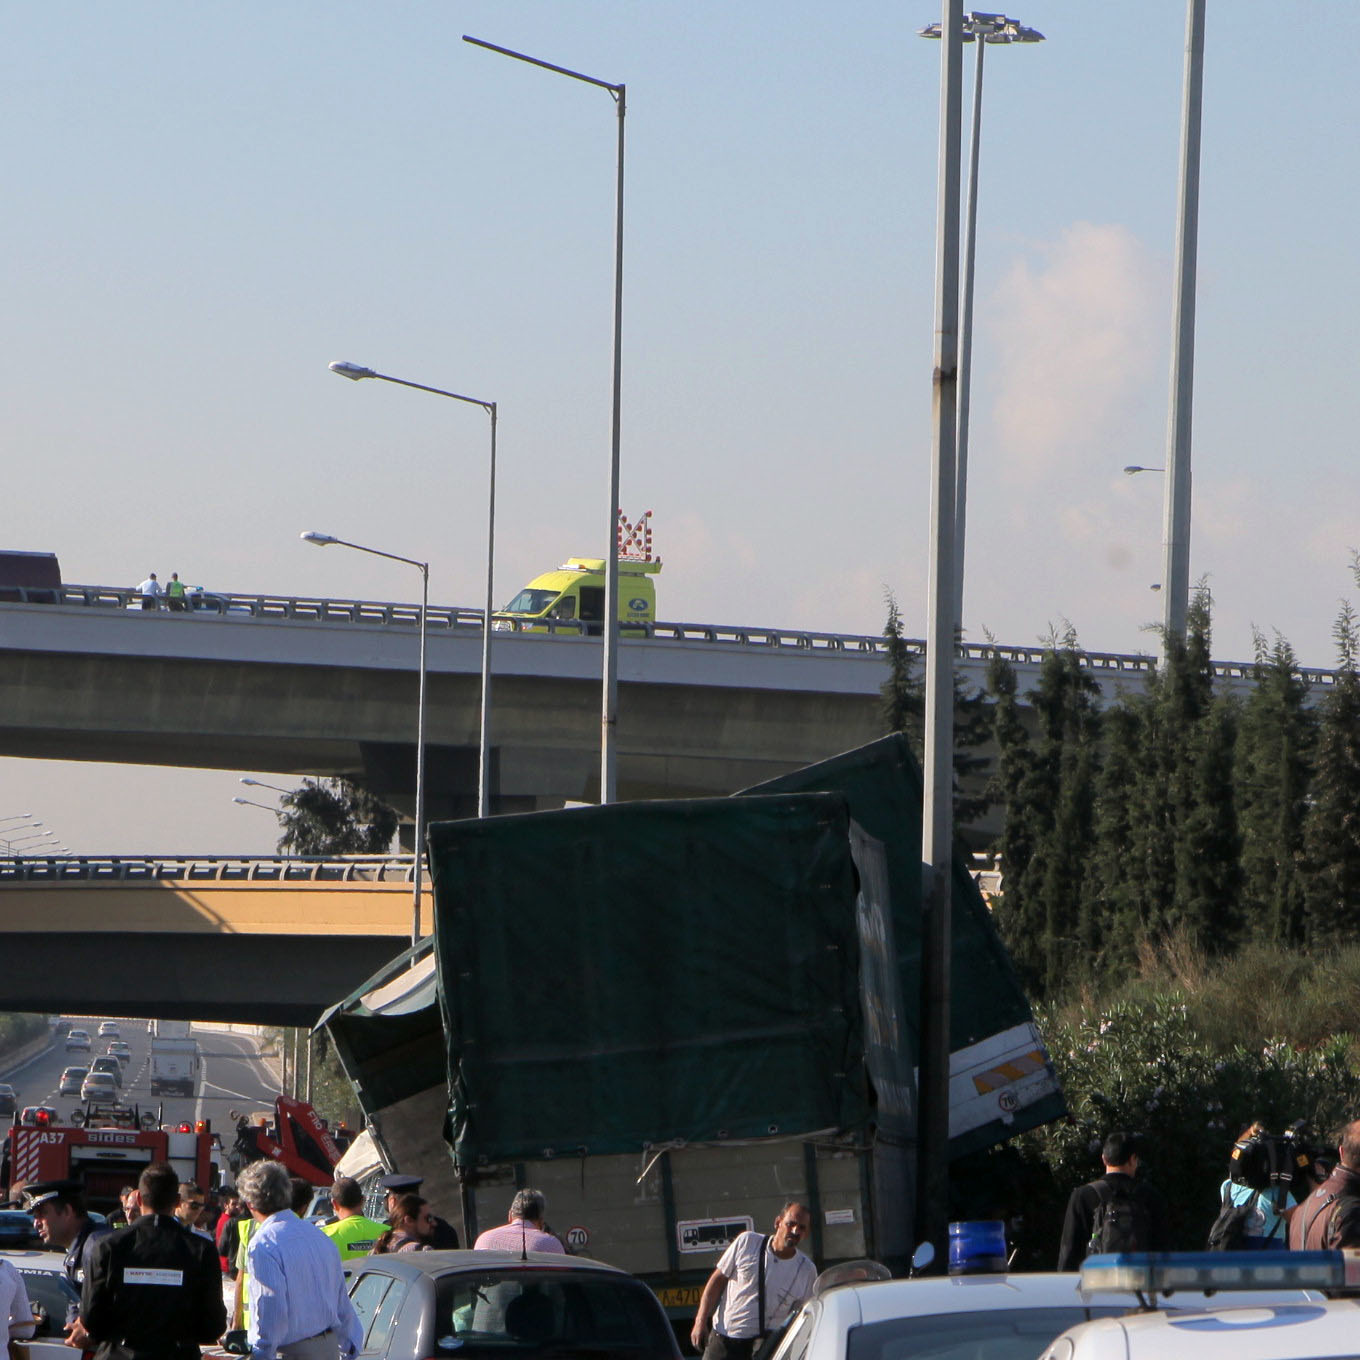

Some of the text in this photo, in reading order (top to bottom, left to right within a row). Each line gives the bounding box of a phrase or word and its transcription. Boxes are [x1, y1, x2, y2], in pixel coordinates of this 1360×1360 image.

[40, 1132, 65, 1145] A37
[88, 1133, 137, 1144] sides
[570, 1230, 586, 1246] 70
